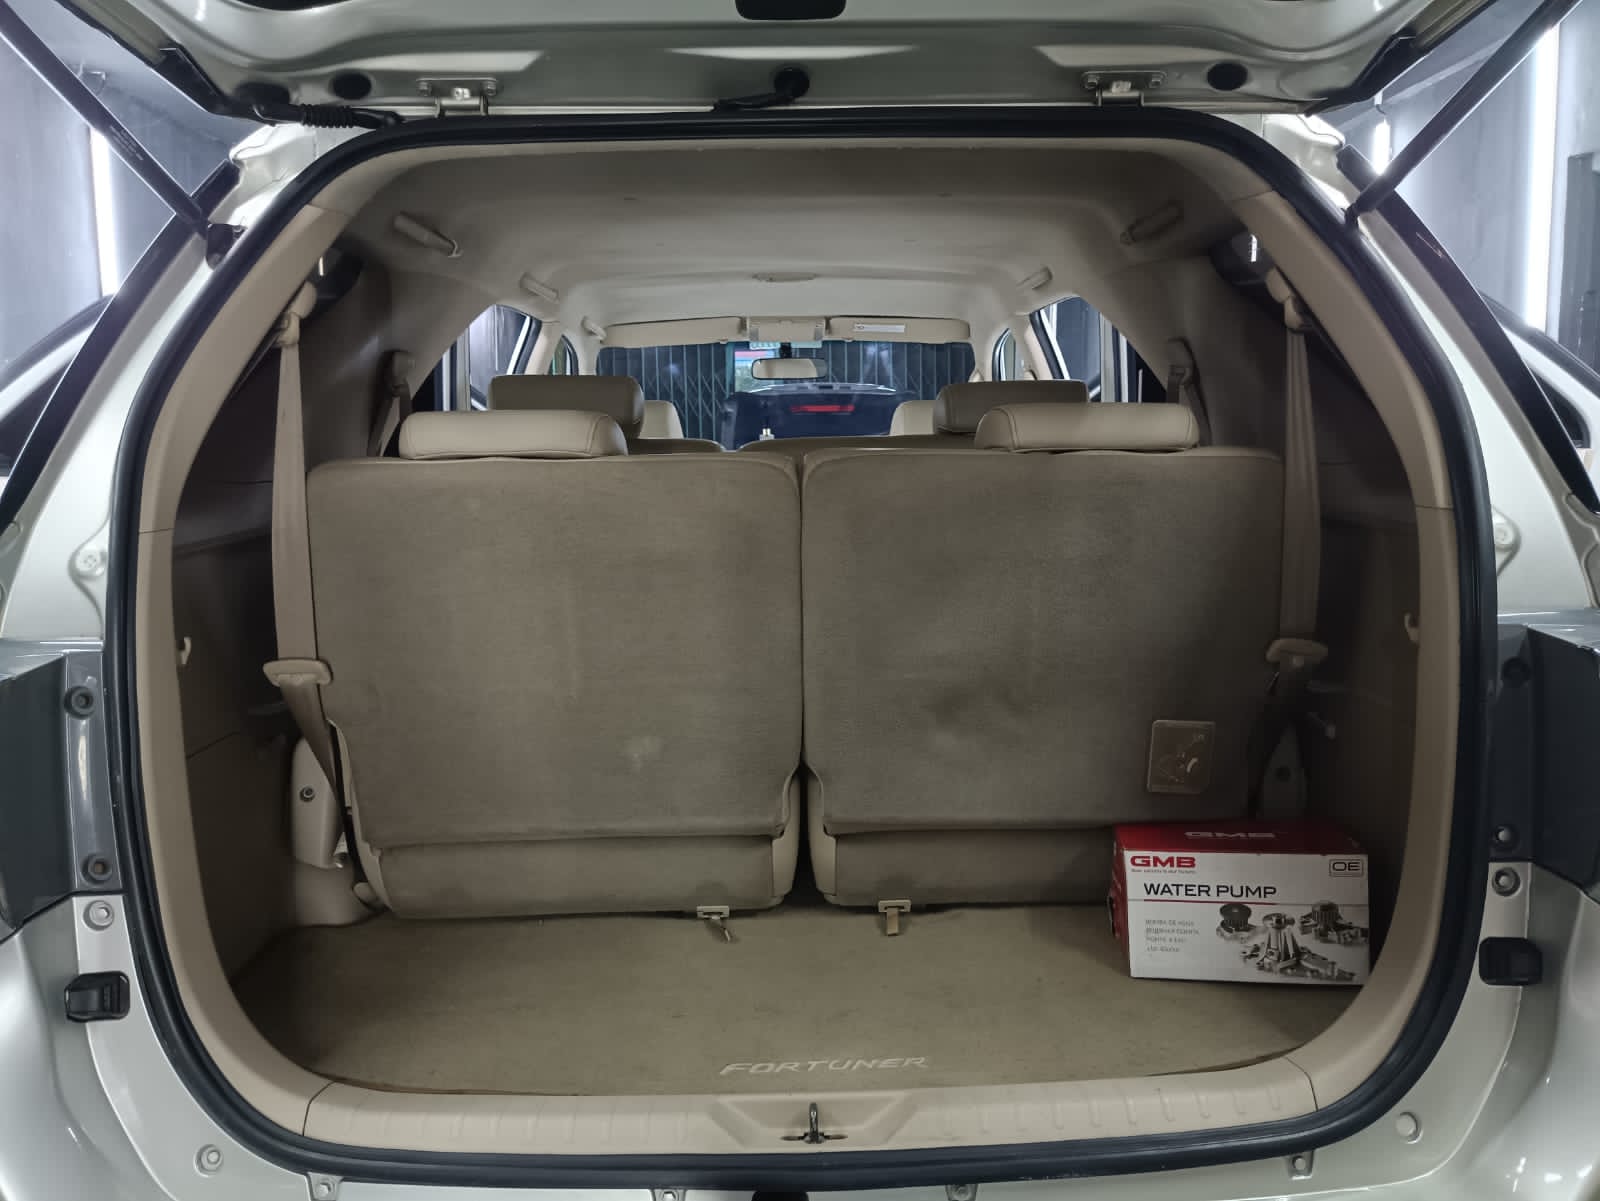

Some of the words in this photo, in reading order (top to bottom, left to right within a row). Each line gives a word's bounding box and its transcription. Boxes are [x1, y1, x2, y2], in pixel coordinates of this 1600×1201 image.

[1184, 831, 1276, 839] GMB
[1130, 855, 1196, 869] GMB
[1332, 860, 1361, 872] OE
[1143, 882, 1211, 897] WATER
[1216, 884, 1277, 899] PUMP
[720, 1056, 928, 1075] FORTUNER
